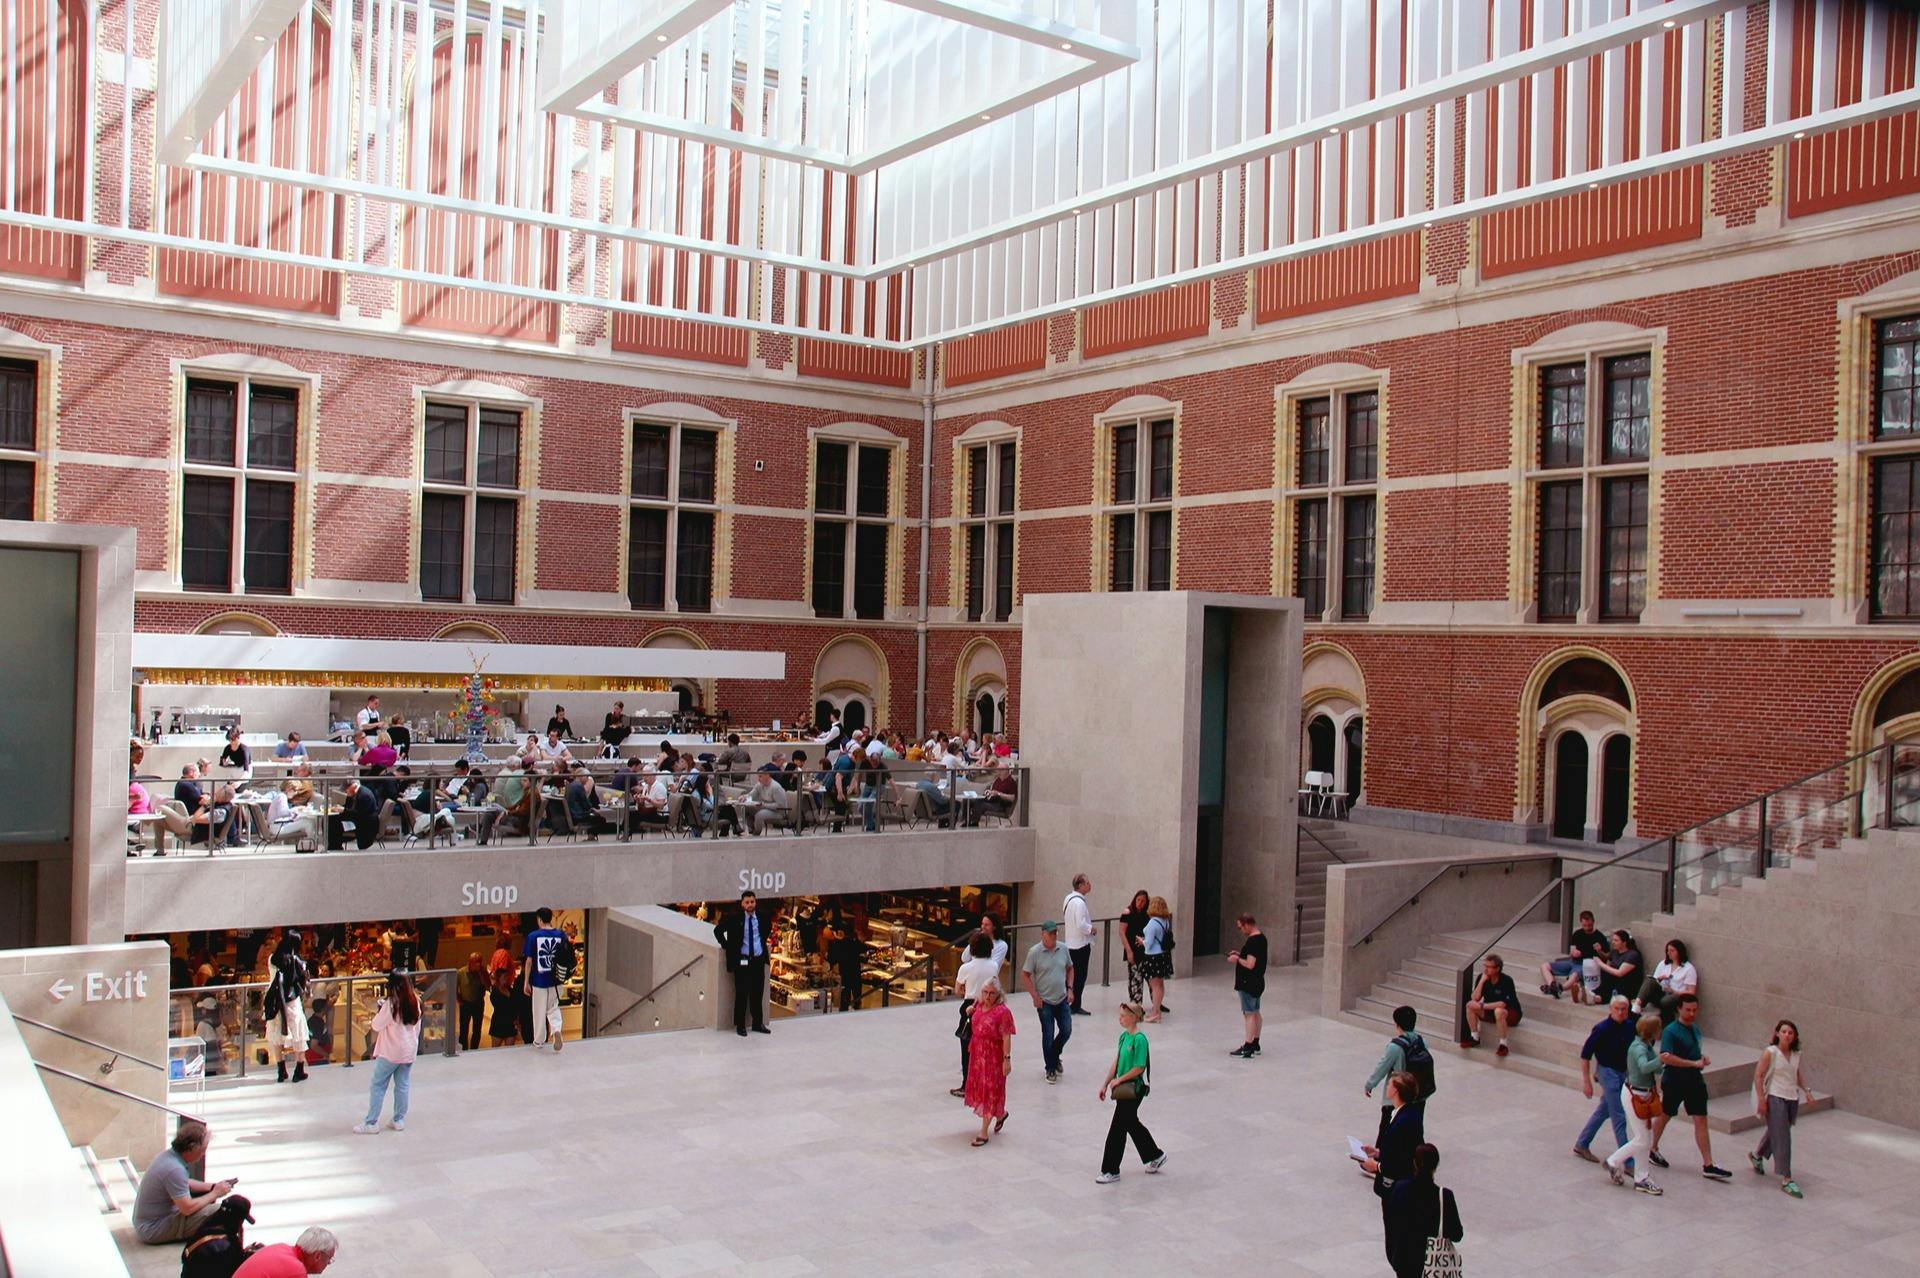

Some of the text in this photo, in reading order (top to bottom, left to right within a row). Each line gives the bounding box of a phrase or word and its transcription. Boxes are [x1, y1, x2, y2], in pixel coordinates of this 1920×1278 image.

[739, 868, 786, 893] Shop
[462, 881, 518, 908] Shop
[86, 970, 148, 1002] Exit
